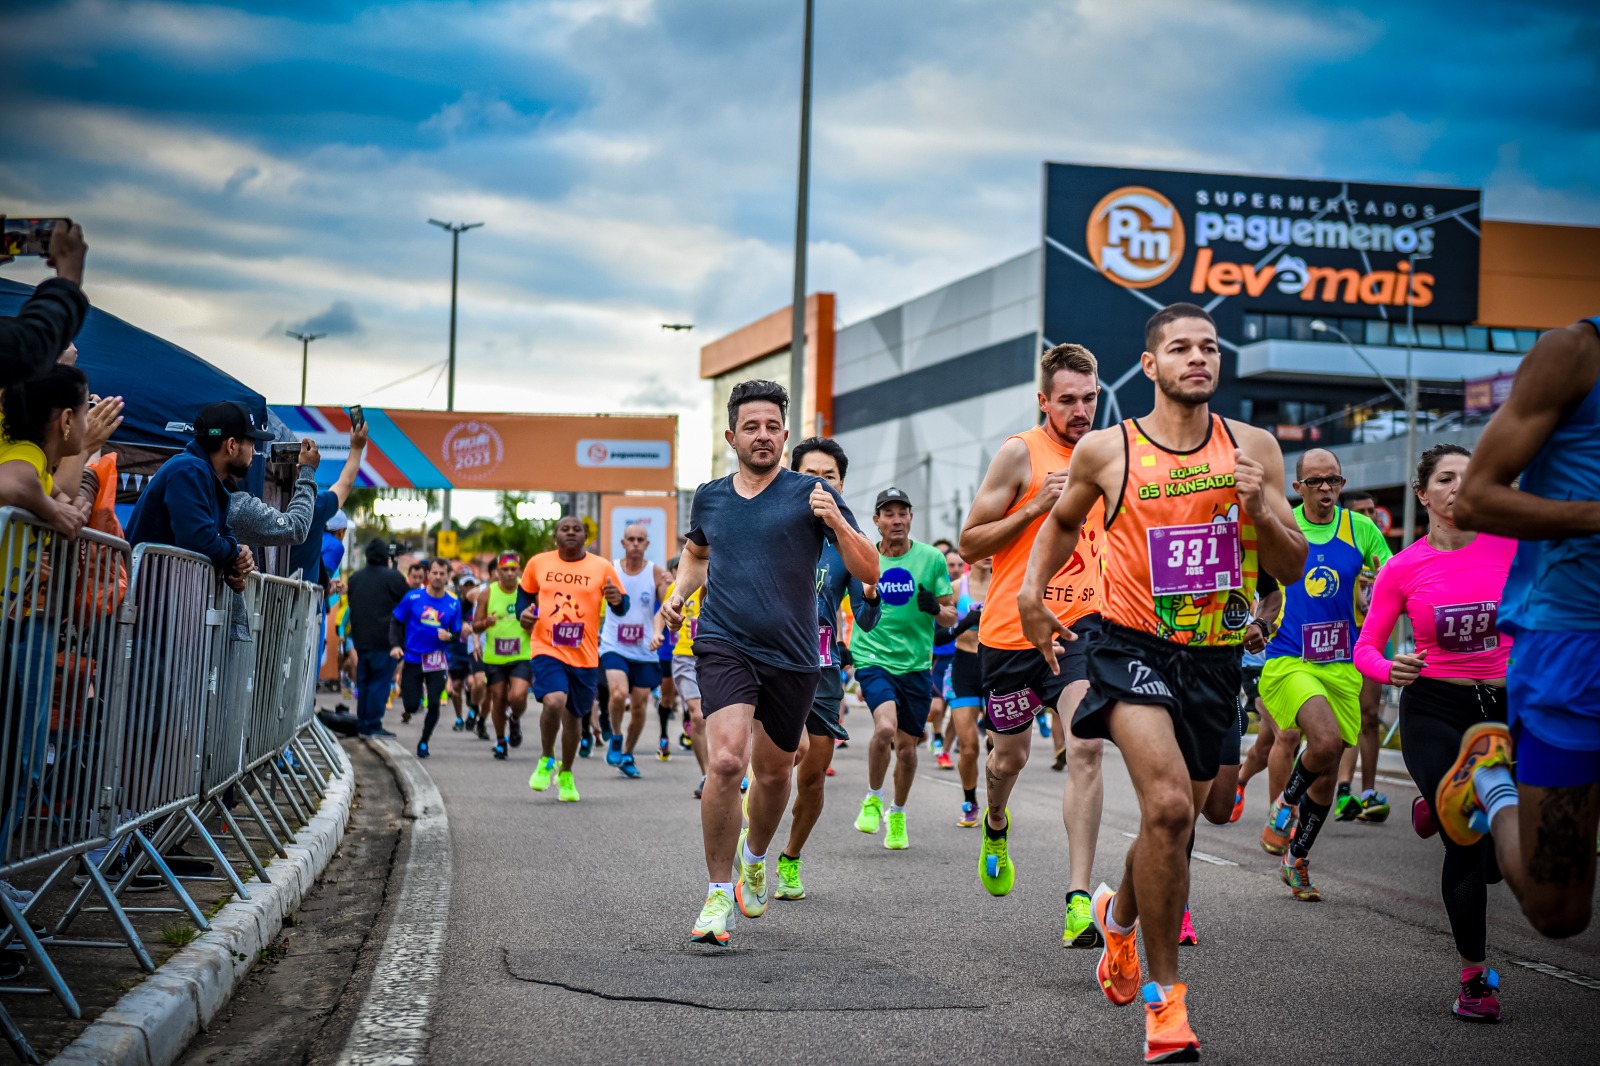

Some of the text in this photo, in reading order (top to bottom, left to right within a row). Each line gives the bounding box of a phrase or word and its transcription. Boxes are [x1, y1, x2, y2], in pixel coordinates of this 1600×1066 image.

[1196, 190, 1435, 220] SUPERMERCADOS
[1195, 211, 1435, 254] paguemenos
[455, 451, 490, 470] 2023
[1169, 464, 1210, 479] EQUIPE
[1138, 485, 1160, 499] OS
[1167, 537, 1220, 568] 331
[545, 571, 592, 586] ECORT
[1185, 566, 1204, 576] JOSE
[879, 580, 914, 593] Vittal
[558, 626, 580, 639] 420
[1443, 612, 1490, 637] 133
[1311, 629, 1340, 648] 015
[992, 696, 1031, 718] 228
[1006, 711, 1024, 721] ELTON
